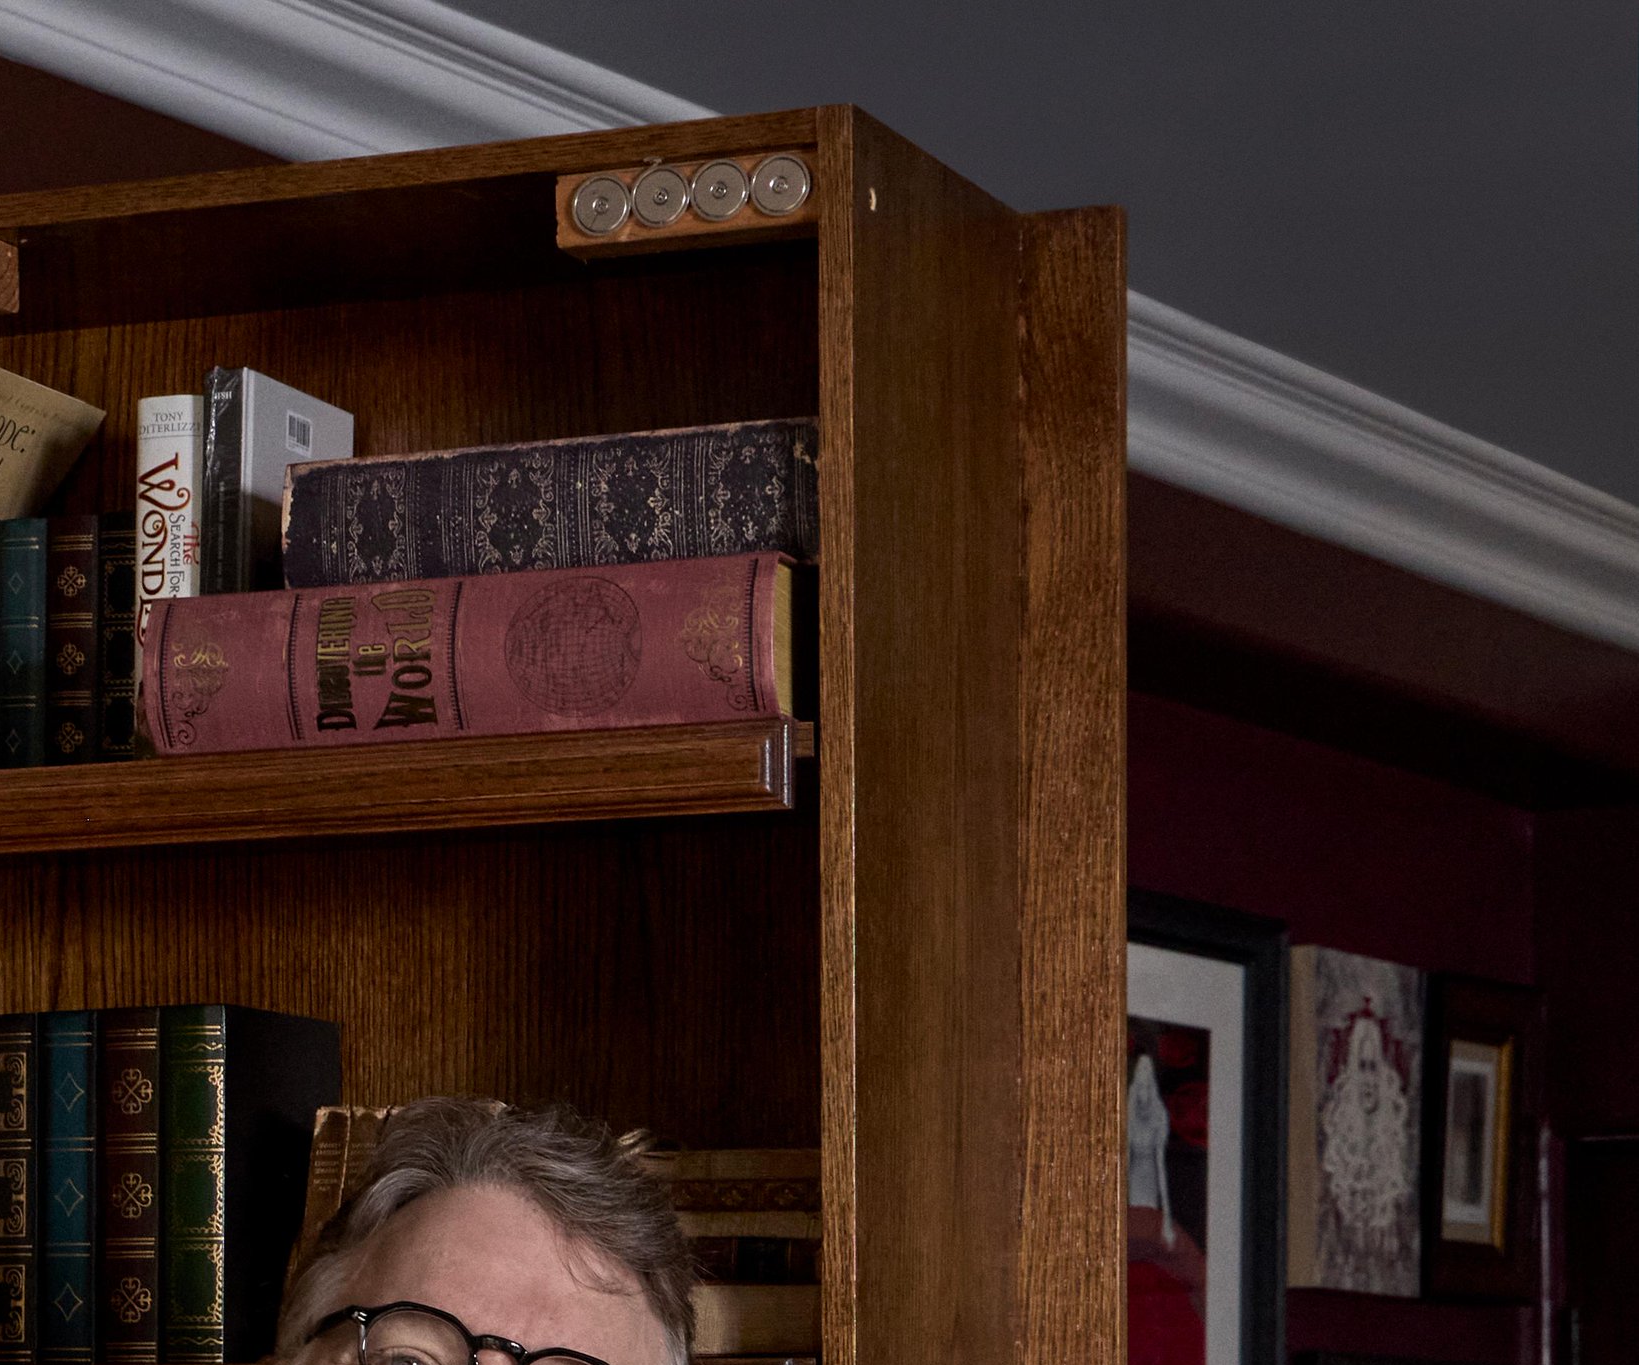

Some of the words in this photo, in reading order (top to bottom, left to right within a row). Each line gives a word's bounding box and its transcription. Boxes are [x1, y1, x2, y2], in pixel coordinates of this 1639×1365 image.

[139, 422, 201, 434] DITERLIZZI
[153, 412, 183, 422] TONY
[182, 521, 200, 566] The
[374, 589, 438, 730] WORLD
